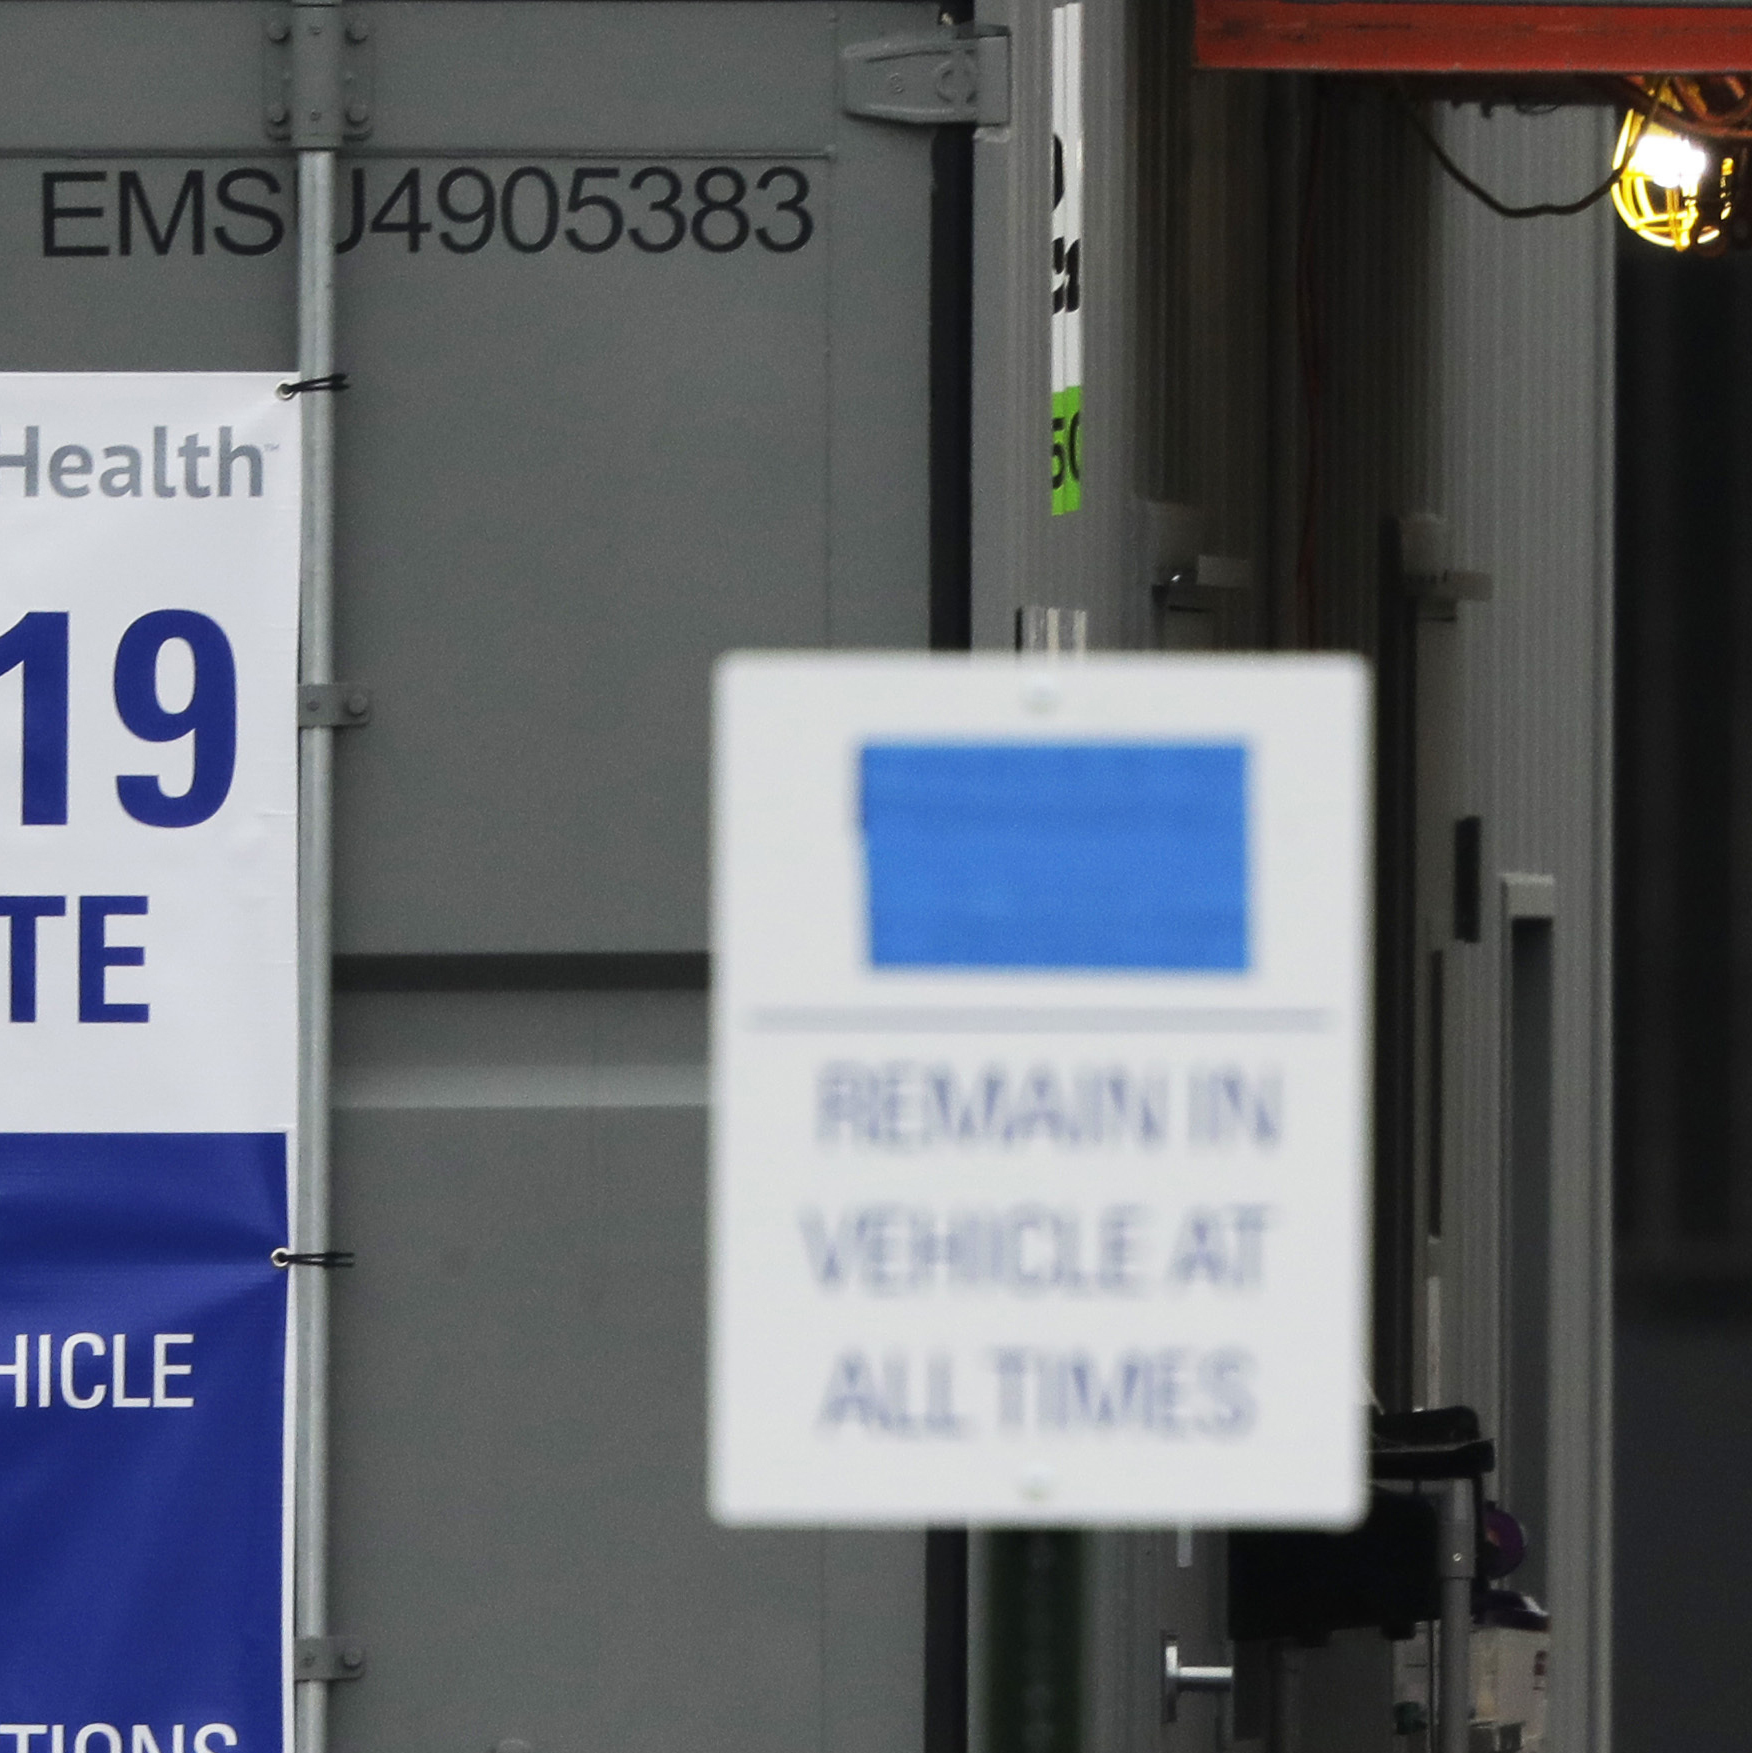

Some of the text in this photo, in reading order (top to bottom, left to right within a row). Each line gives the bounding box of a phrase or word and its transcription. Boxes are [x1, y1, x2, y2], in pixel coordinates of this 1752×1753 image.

[815, 1060, 1282, 1152] REMAIN IN
[799, 1205, 1276, 1291] VEHICLE AT
[817, 1346, 1259, 1436] ALL TIMES
